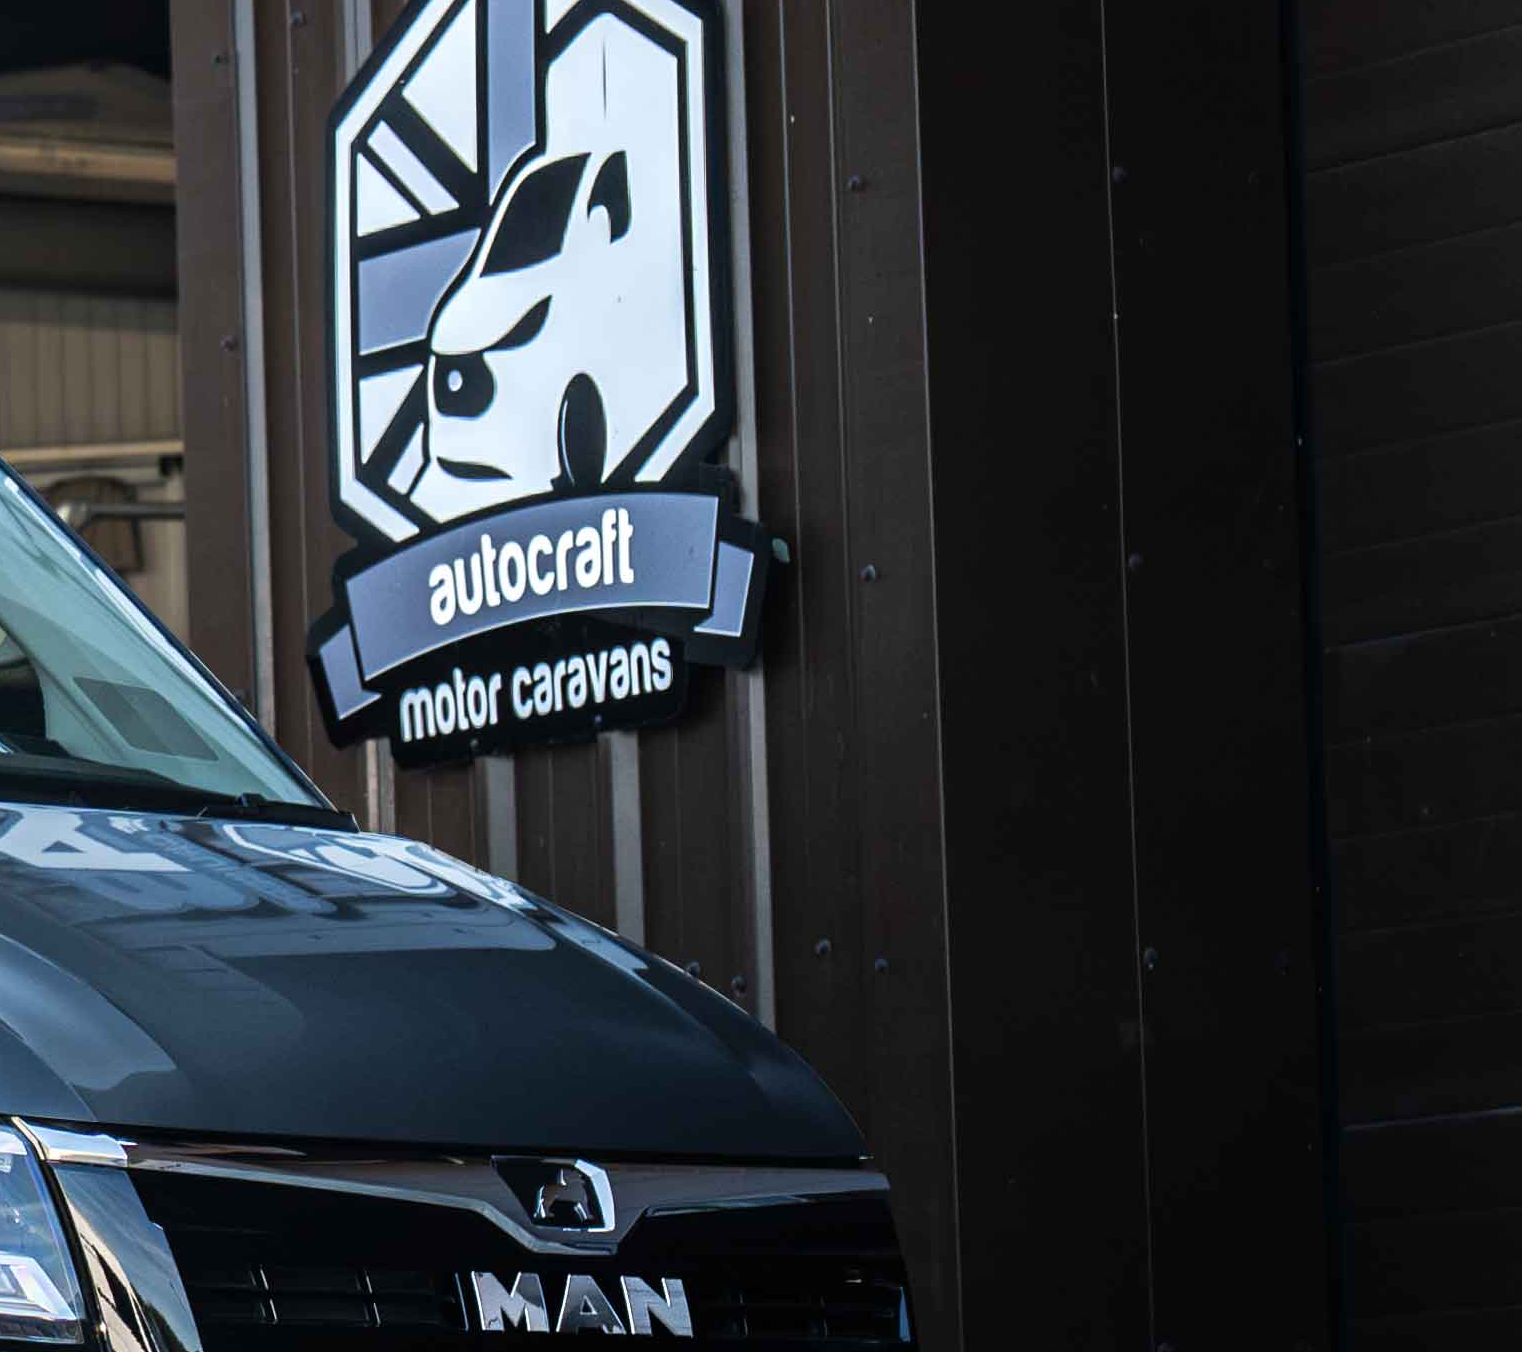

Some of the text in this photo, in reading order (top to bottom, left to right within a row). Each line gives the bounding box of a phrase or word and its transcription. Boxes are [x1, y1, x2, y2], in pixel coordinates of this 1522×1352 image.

[428, 507, 634, 626] autocraft
[399, 637, 673, 743] motor caravans
[471, 1270, 695, 1338] MAN
